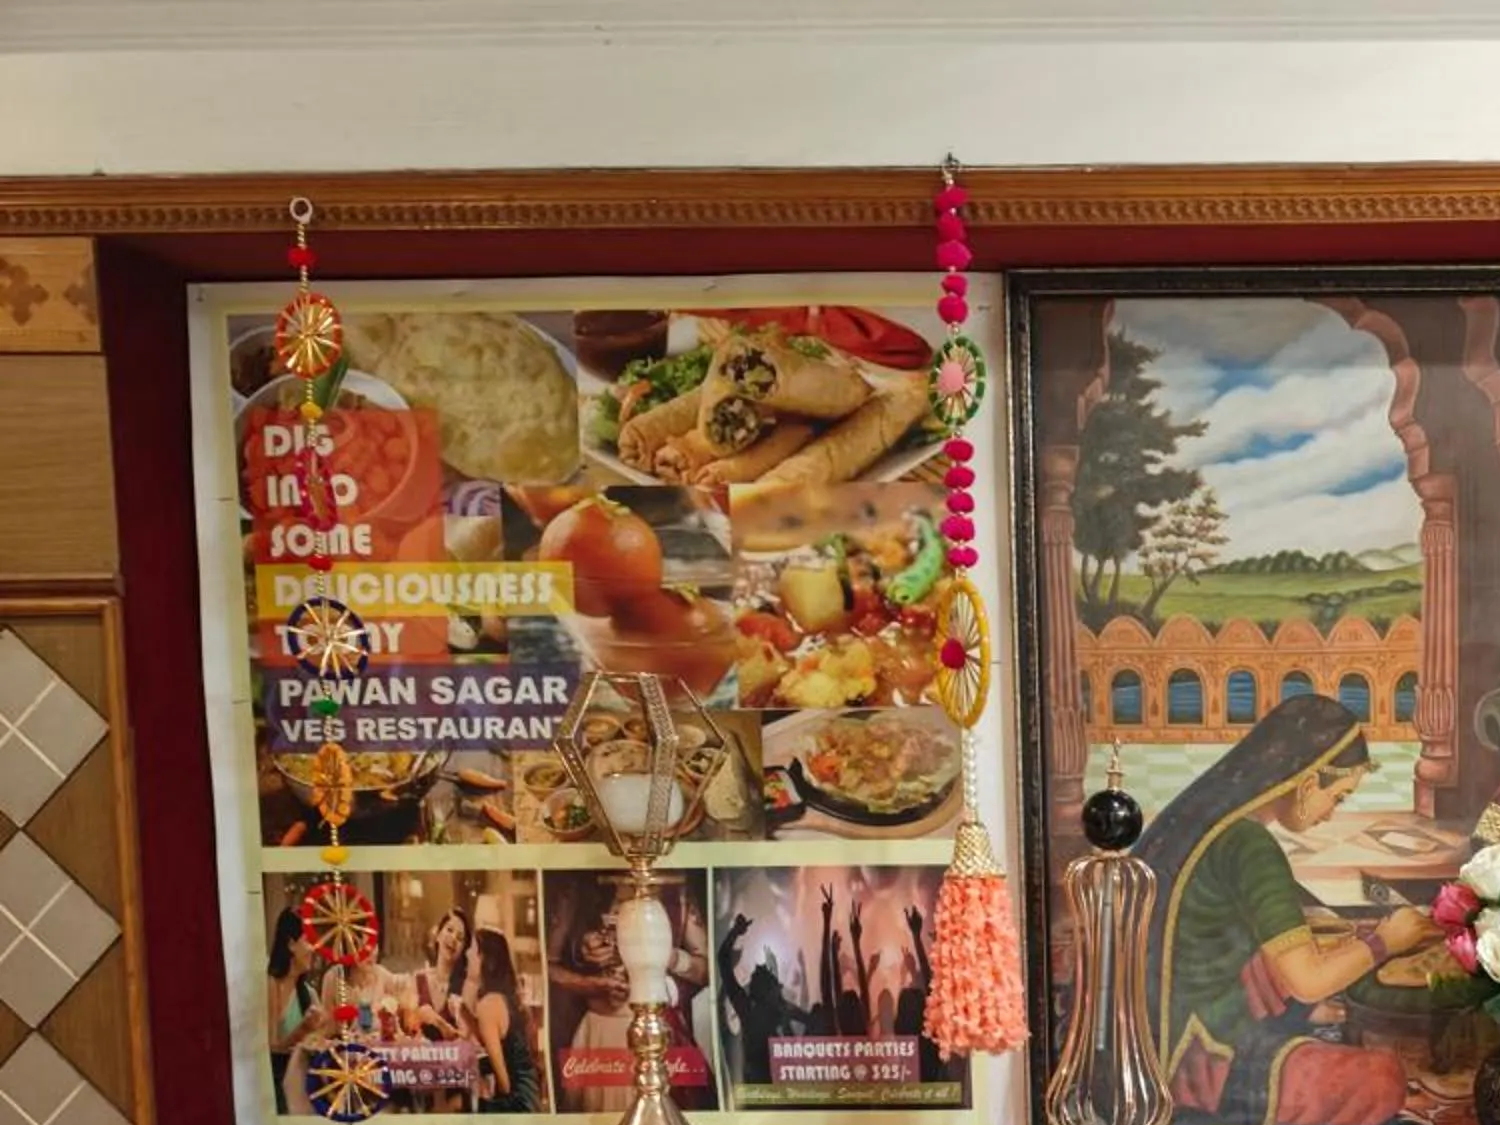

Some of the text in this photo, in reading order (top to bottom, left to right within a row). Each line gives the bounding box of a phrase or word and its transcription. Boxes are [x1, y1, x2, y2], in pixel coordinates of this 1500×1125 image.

[263, 424, 334, 457] DIG
[267, 473, 358, 508] INO
[271, 523, 371, 557] SOME
[274, 572, 553, 607] DELICIOUSNESS
[280, 675, 568, 707] PAWAN SAGAR
[281, 719, 346, 742] VEG
[772, 1041, 915, 1059] BANQUETS PARTIES
[780, 1064, 850, 1081] STARTING
